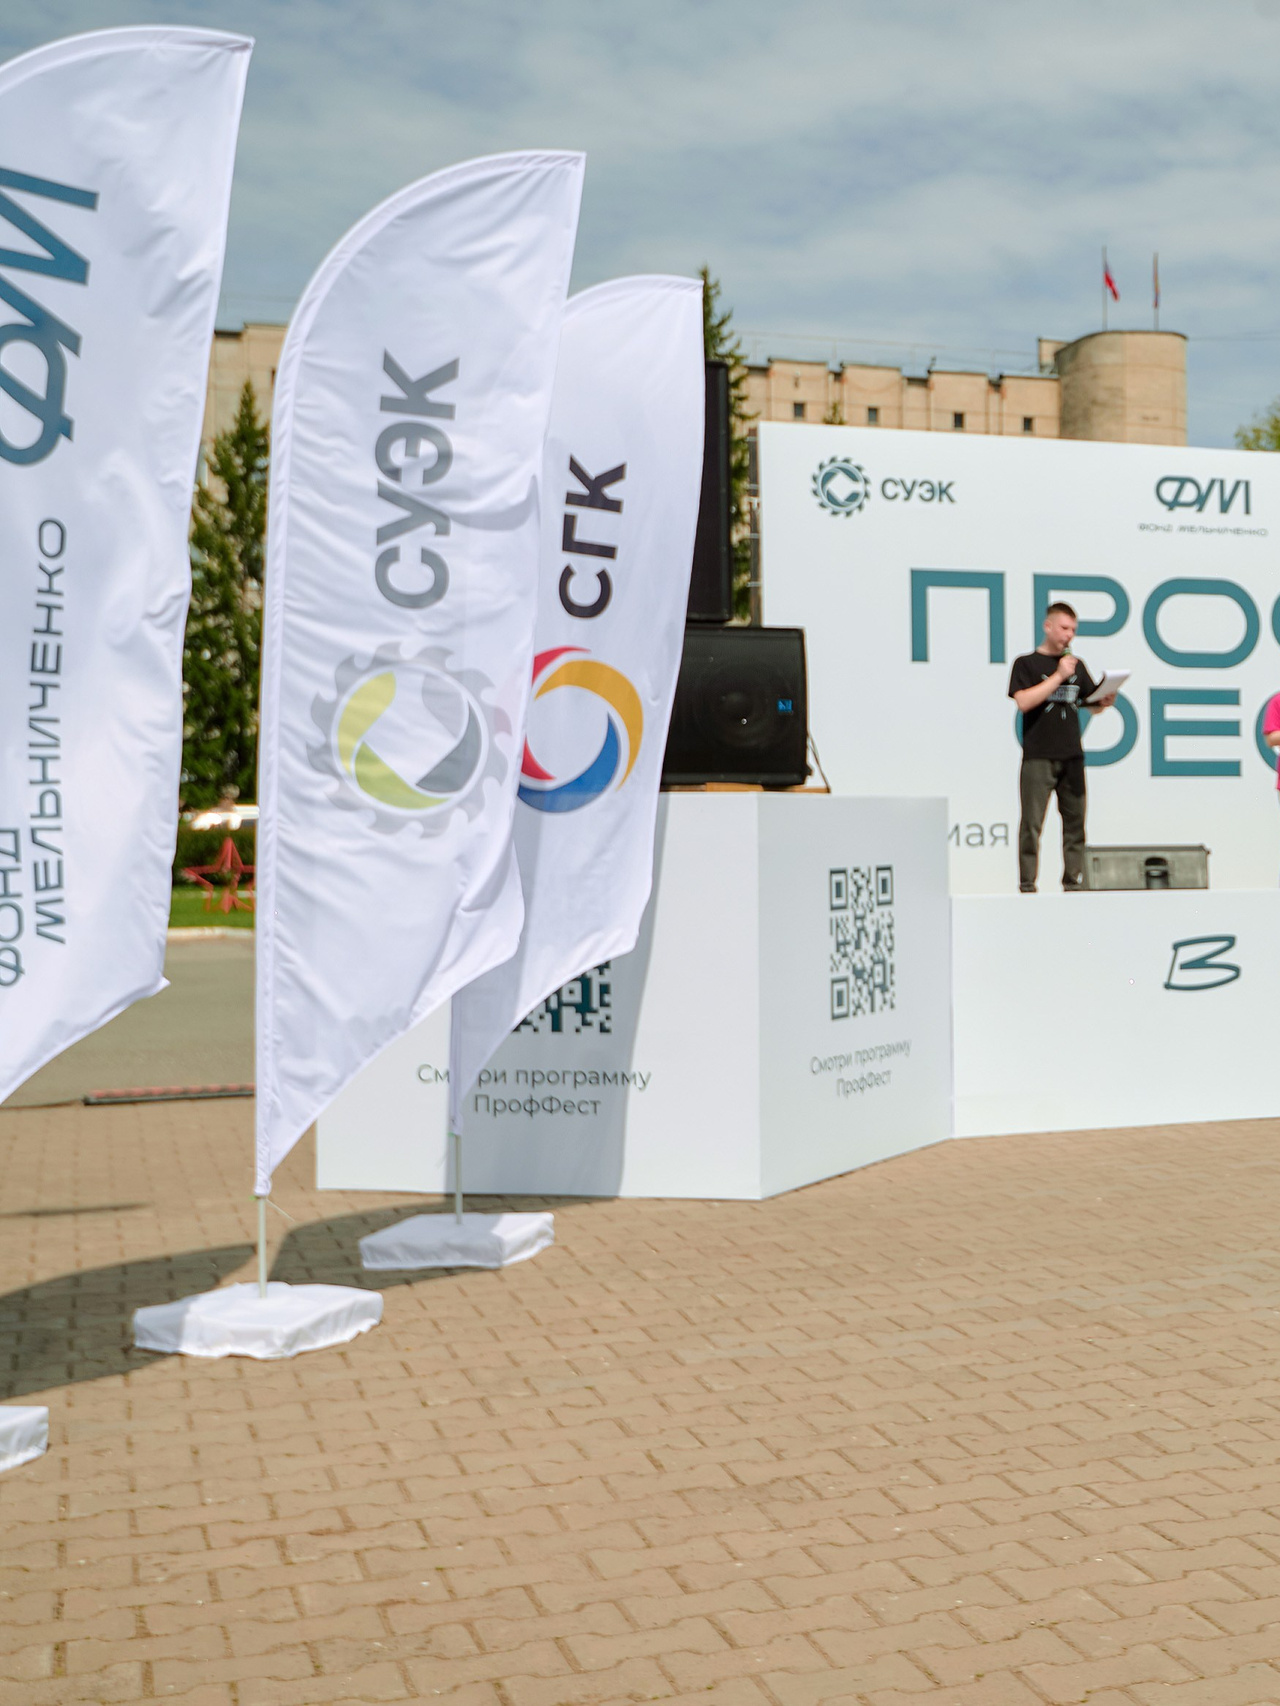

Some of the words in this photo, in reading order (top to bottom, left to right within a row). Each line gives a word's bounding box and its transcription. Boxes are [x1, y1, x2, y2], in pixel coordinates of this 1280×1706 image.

[375, 347, 460, 610] СУЭК
[881, 477, 956, 503] СУЭК
[559, 453, 627, 619] СГК
[28, 518, 67, 944] МЕЛЬНИЧЕНКО
[1163, 934, 1241, 991] В
[417, 1064, 507, 1088] Смри
[516, 1067, 652, 1091] программу
[474, 1094, 601, 1117] ПрофФест
